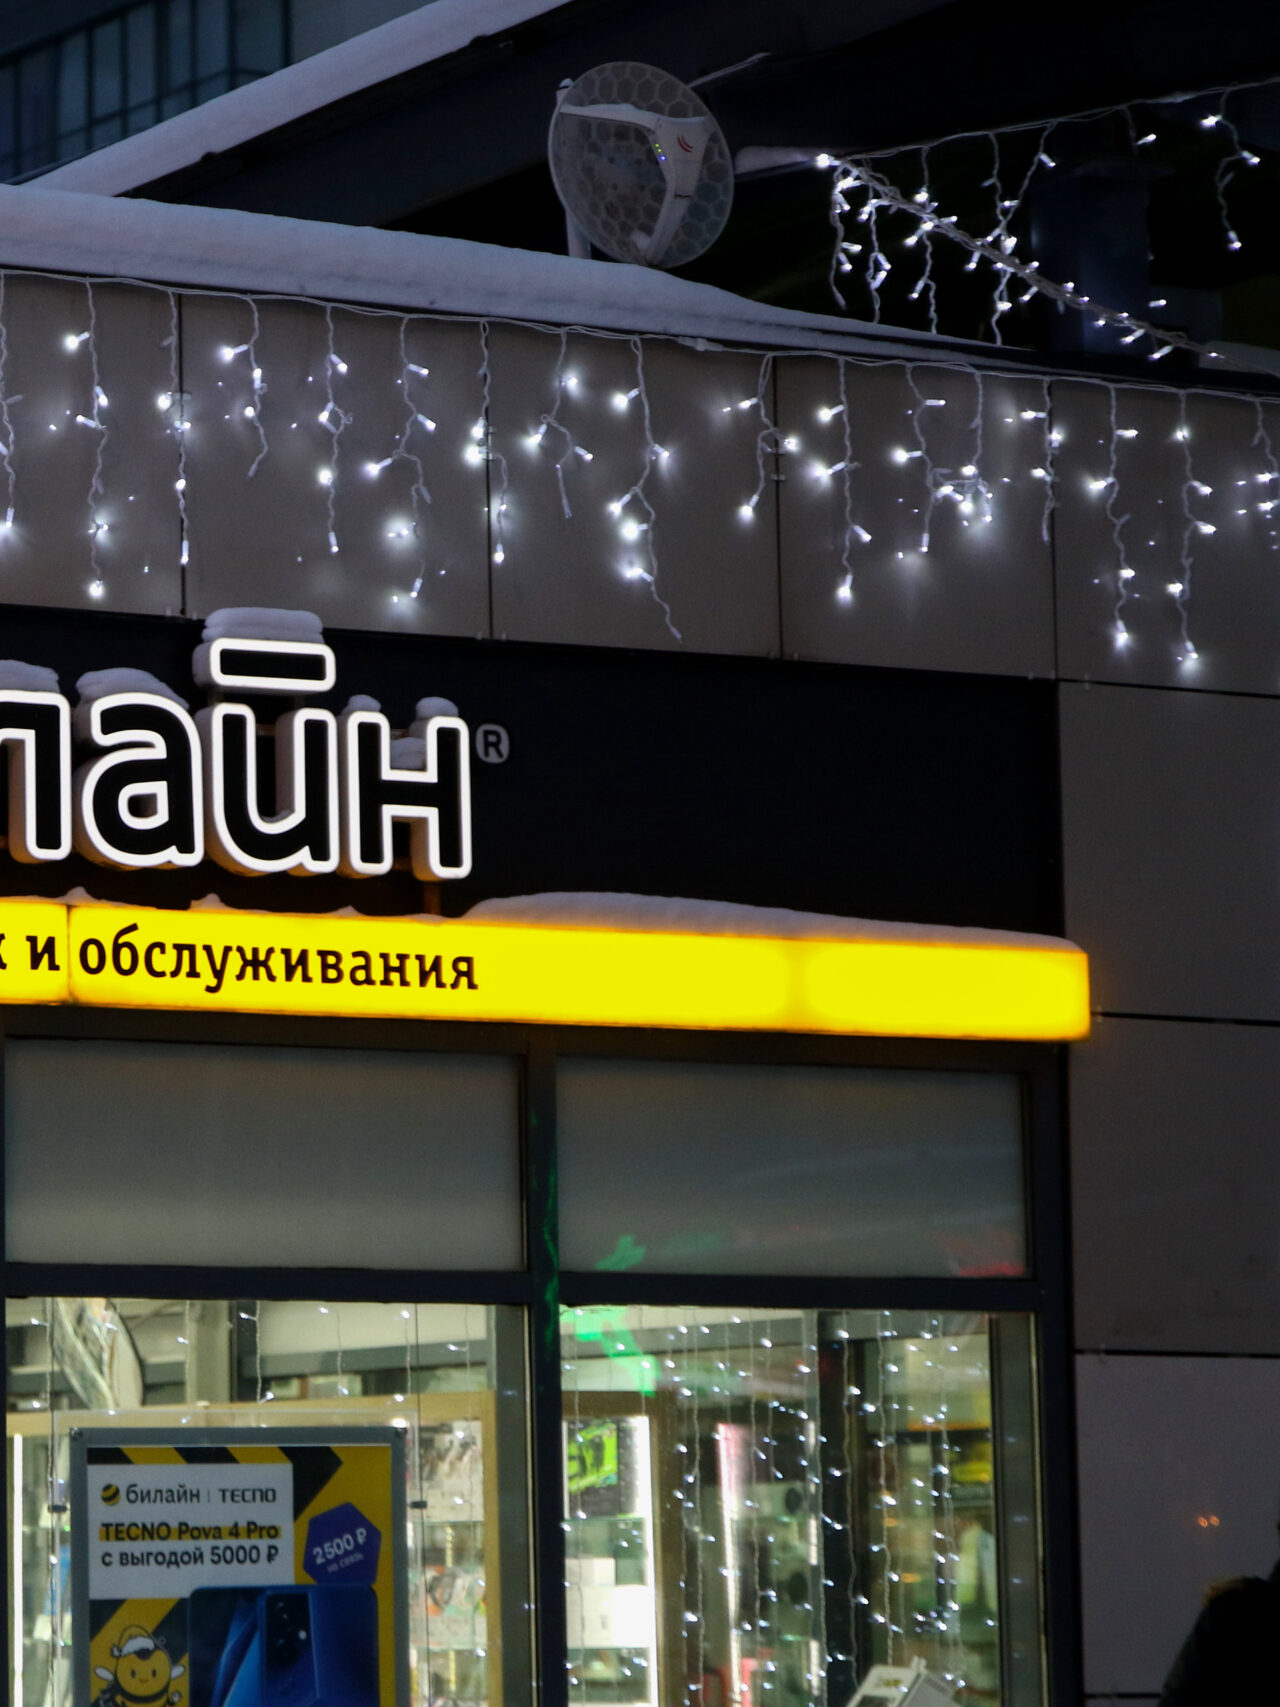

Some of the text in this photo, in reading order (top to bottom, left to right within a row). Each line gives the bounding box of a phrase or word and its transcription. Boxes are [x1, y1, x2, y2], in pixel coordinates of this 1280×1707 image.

[25, 934, 61, 972] и
[79, 924, 480, 992] обслуживания
[125, 1484, 200, 1504] билайн
[101, 1521, 280, 1541] TECNO Pova 4 Pro
[101, 1553, 113, 1566] с
[119, 1547, 204, 1569] выгодой
[210, 1545, 261, 1565] 5000
[312, 1533, 355, 1565] 2500
